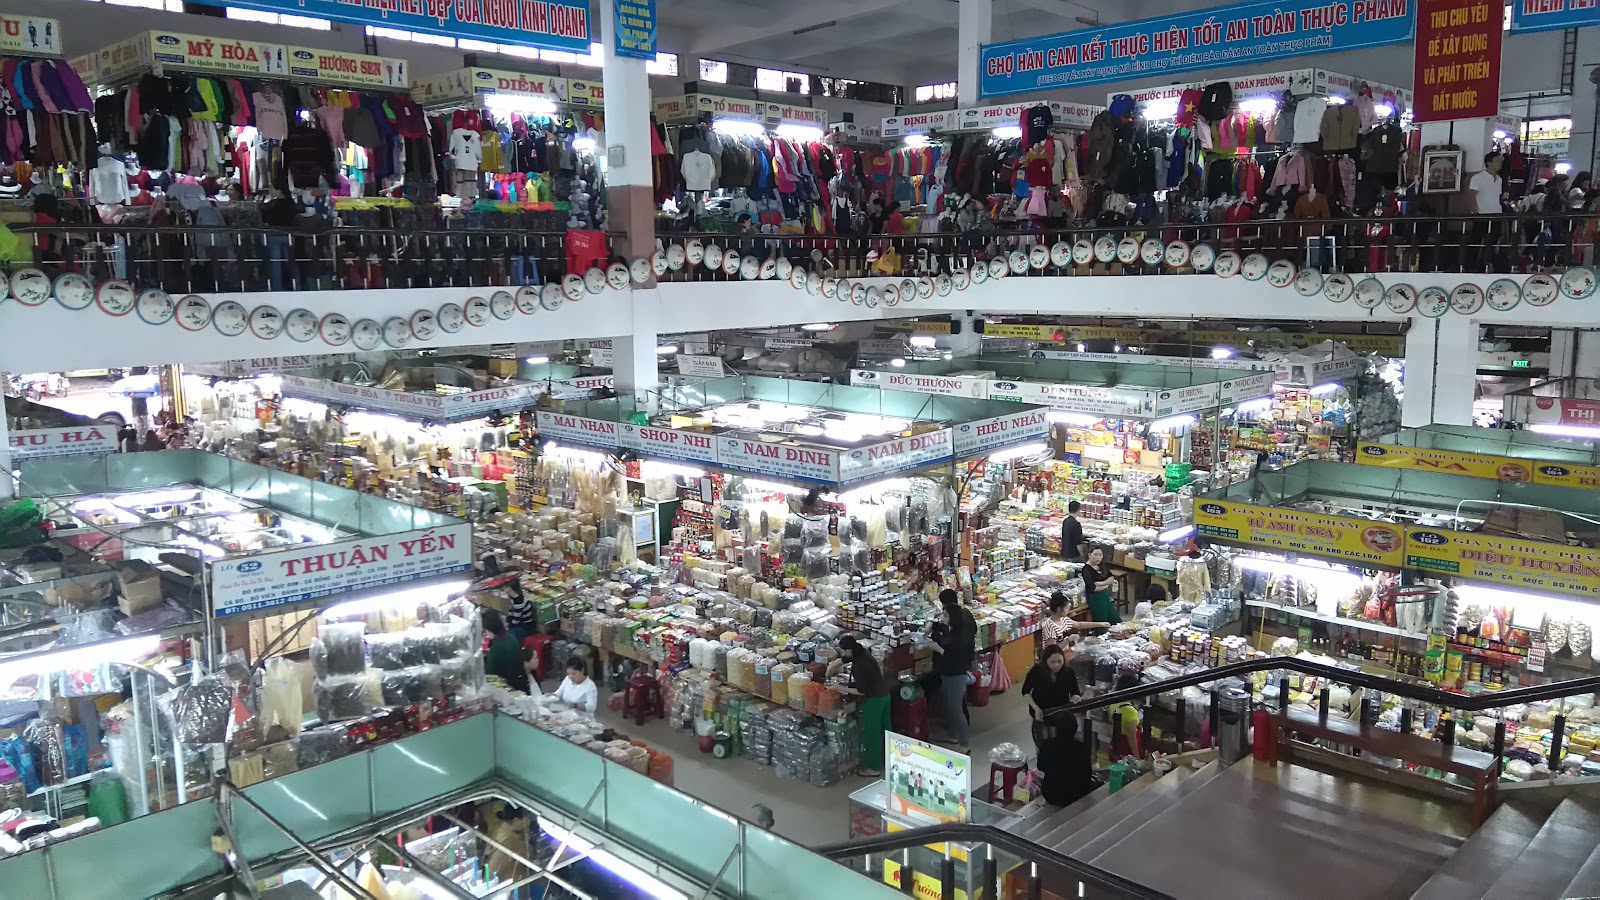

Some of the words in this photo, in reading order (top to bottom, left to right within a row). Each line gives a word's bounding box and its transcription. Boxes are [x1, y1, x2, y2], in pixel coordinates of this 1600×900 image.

[521, 1, 551, 34] KINH
[550, 3, 588, 39] DOANH
[1431, 10, 1448, 29] THU
[1450, 3, 1469, 26] CHỦ
[1471, 2, 1489, 24] YẾU
[987, 53, 1014, 79] CHỢ
[1017, 50, 1044, 75] HÀN
[1047, 47, 1078, 69] CAM
[1081, 34, 1110, 65] KẾT
[1112, 33, 1145, 61] THỰC
[1153, 26, 1188, 54] HIỆN
[1193, 16, 1222, 47] TỐT
[1225, 20, 1248, 43] AN
[1252, 9, 1297, 38] TOÀN
[1301, 2, 1349, 33] THỰC
[1428, 33, 1440, 57] ĐỂ
[1442, 34, 1461, 56] XÂY
[1462, 33, 1488, 56] DỰNG
[187, 38, 215, 59] MỸ
[220, 42, 259, 64] HÒA
[1243, 46, 1255, 57] AN
[318, 54, 358, 75] HƯƠNG
[361, 60, 382, 77] SEN
[1424, 62, 1436, 85] VÀ
[1438, 61, 1461, 84] PHÁT
[1463, 54, 1490, 81] TRIỂN
[486, 75, 545, 95] DIỄM
[1255, 75, 1286, 90] PHƯƠNG
[1133, 89, 1161, 103] PHƯỚC
[1163, 86, 1181, 99] LIÊN
[1433, 87, 1450, 112] ĐẤT
[1451, 86, 1478, 109] NƯỚC
[727, 102, 751, 117] MINH
[984, 106, 1003, 120] PHÚ
[1062, 106, 1076, 118] PHÚ
[904, 116, 928, 129] ĐỊNH
[930, 114, 945, 126] 159
[588, 339, 613, 349] TRUNG
[250, 356, 278, 368] KIM
[282, 354, 311, 367] SEN
[1512, 360, 1529, 368] EXIT
[889, 373, 913, 387] ĐỨC
[914, 377, 963, 391] THƯƠNG
[468, 385, 522, 404] THUẬN
[1059, 386, 1108, 398] NHUNG
[1567, 407, 1595, 422] THỊ
[553, 415, 576, 429] MAI
[579, 419, 615, 435] NHẠN
[976, 417, 1008, 436] HIẾU
[1011, 411, 1046, 429] NHÂN
[60, 427, 106, 444] HÀ
[639, 427, 679, 444] SHOP
[683, 433, 712, 450] NHI
[743, 441, 781, 460] NAM
[785, 447, 831, 467] ĐỊNH
[868, 441, 906, 461] NAM
[910, 431, 948, 451] ĐỊNH
[1390, 448, 1410, 457] GIA
[1573, 469, 1597, 477] GIA
[1232, 506, 1255, 516] GIA
[1267, 520, 1297, 534] ANH
[1419, 537, 1440, 546] 152
[1452, 536, 1481, 548] GIA
[1507, 544, 1554, 557] THỰC
[279, 543, 390, 578] THUẬN
[397, 530, 456, 558] YẾN
[240, 561, 259, 572] 52
[1459, 548, 1516, 566] DIỆU
[1519, 556, 1600, 580] HUYỀN
